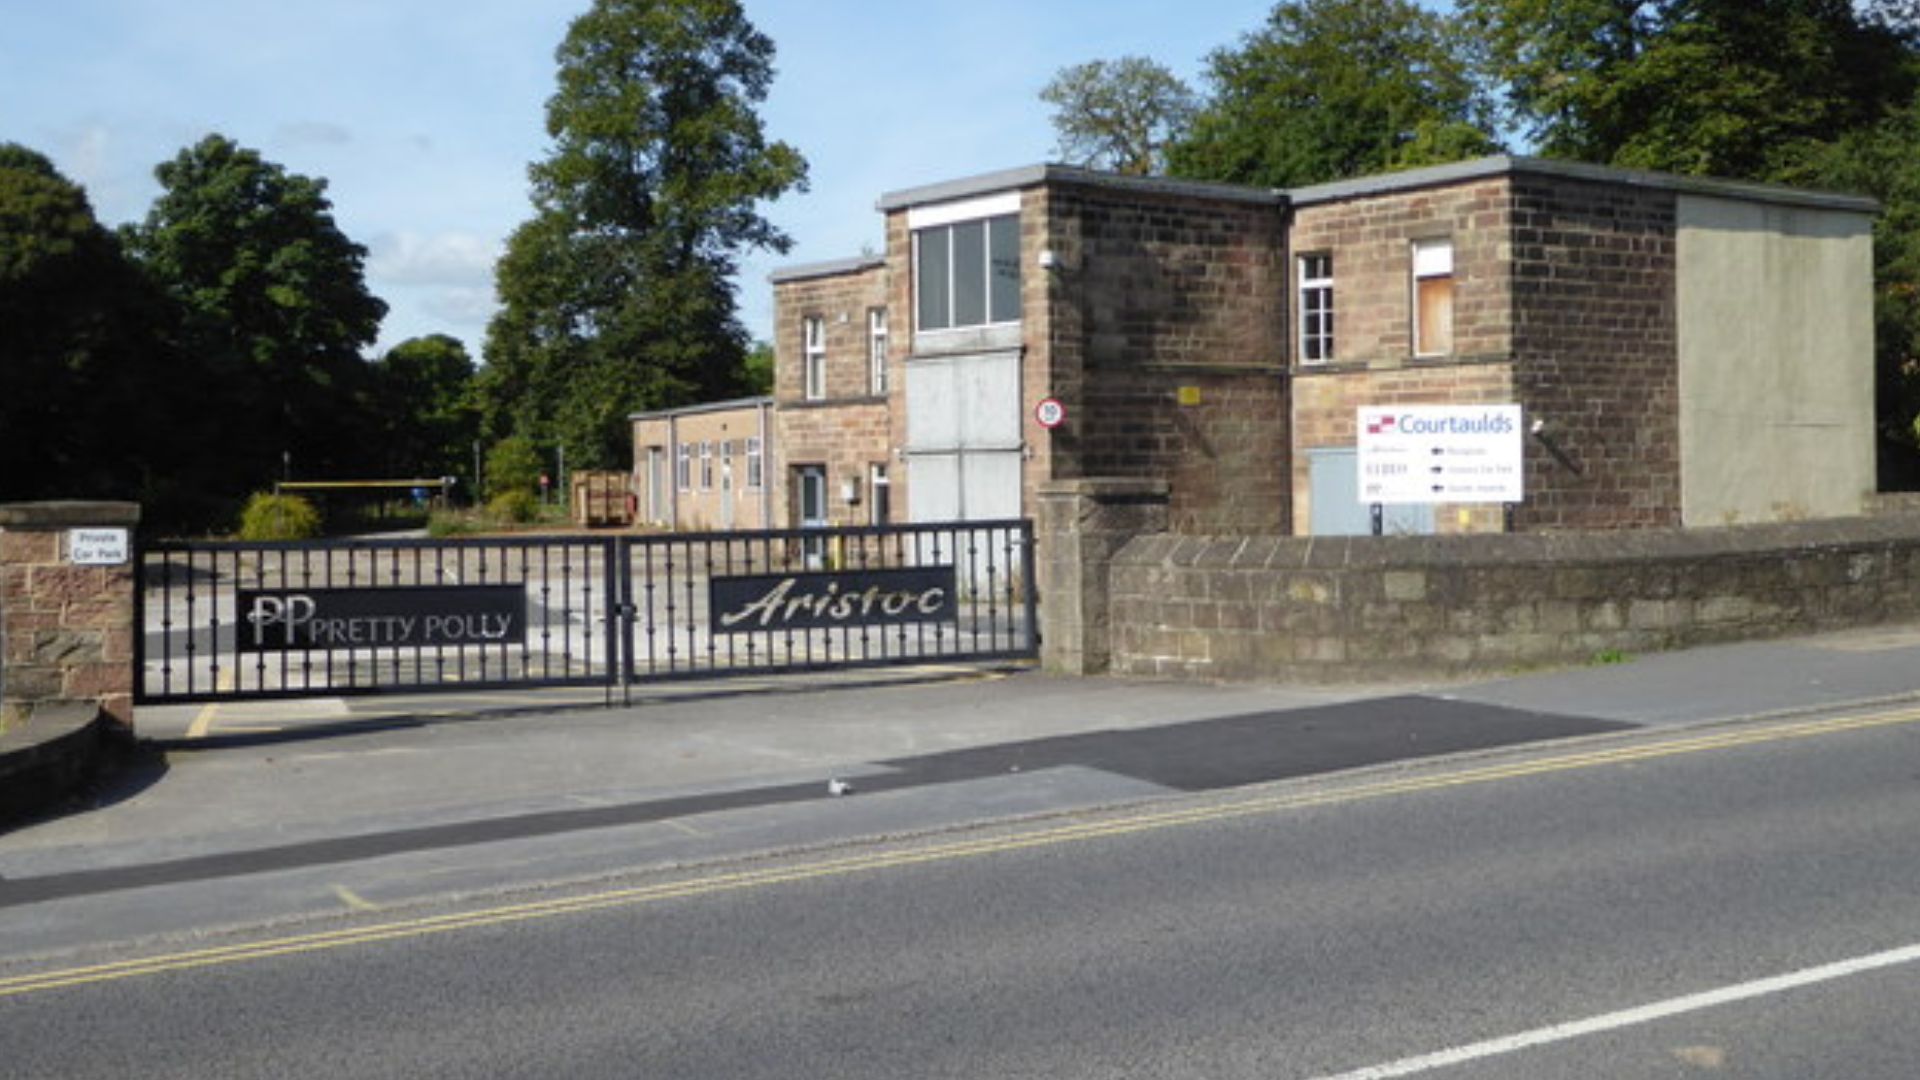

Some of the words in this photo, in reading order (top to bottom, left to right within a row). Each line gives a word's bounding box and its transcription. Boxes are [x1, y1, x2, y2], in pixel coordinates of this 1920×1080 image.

[1400, 413, 1513, 434] Courtaulds
[80, 531, 118, 543] Private
[74, 547, 93, 560] Car
[98, 547, 122, 558] Park
[720, 578, 944, 626] Aristoc
[309, 617, 415, 642] PRETTY
[425, 613, 511, 639] POLLY
